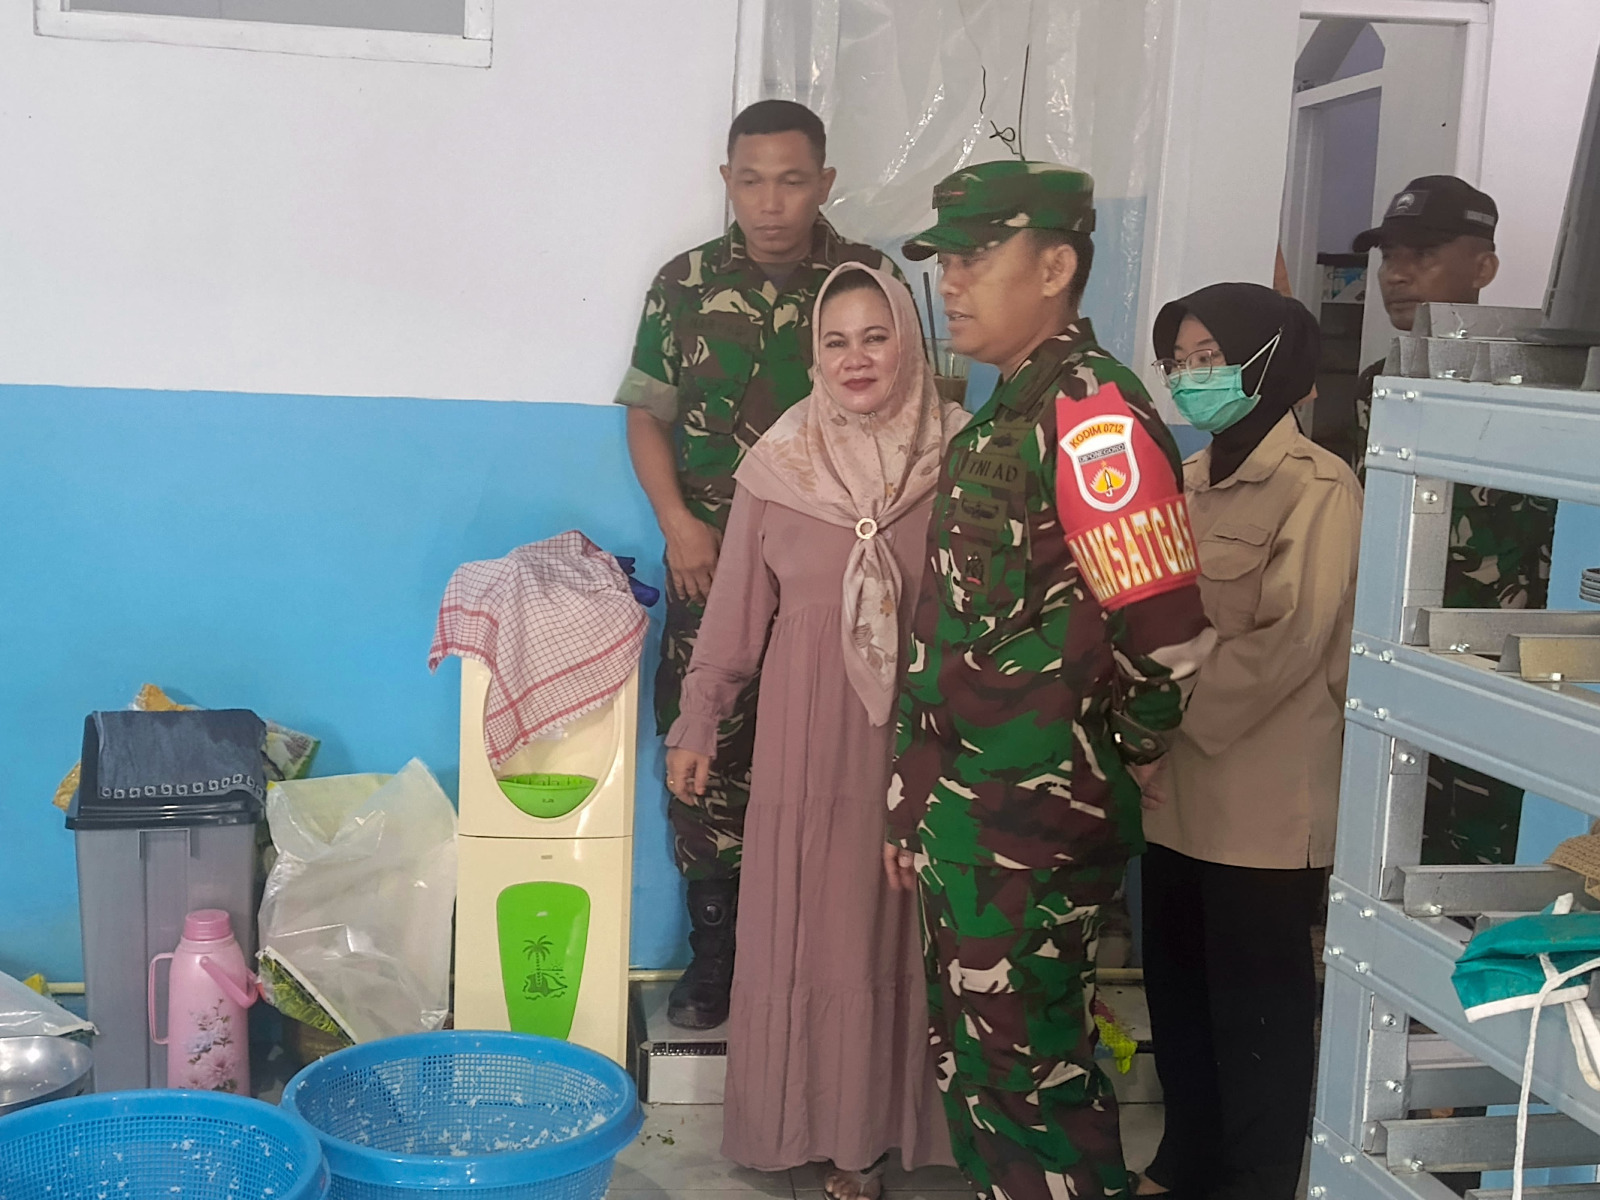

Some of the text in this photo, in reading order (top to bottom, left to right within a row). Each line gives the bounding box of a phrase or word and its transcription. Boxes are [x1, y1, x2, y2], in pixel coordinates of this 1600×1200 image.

[1069, 422, 1125, 449] KODIM 0712
[992, 466, 1018, 483] AD
